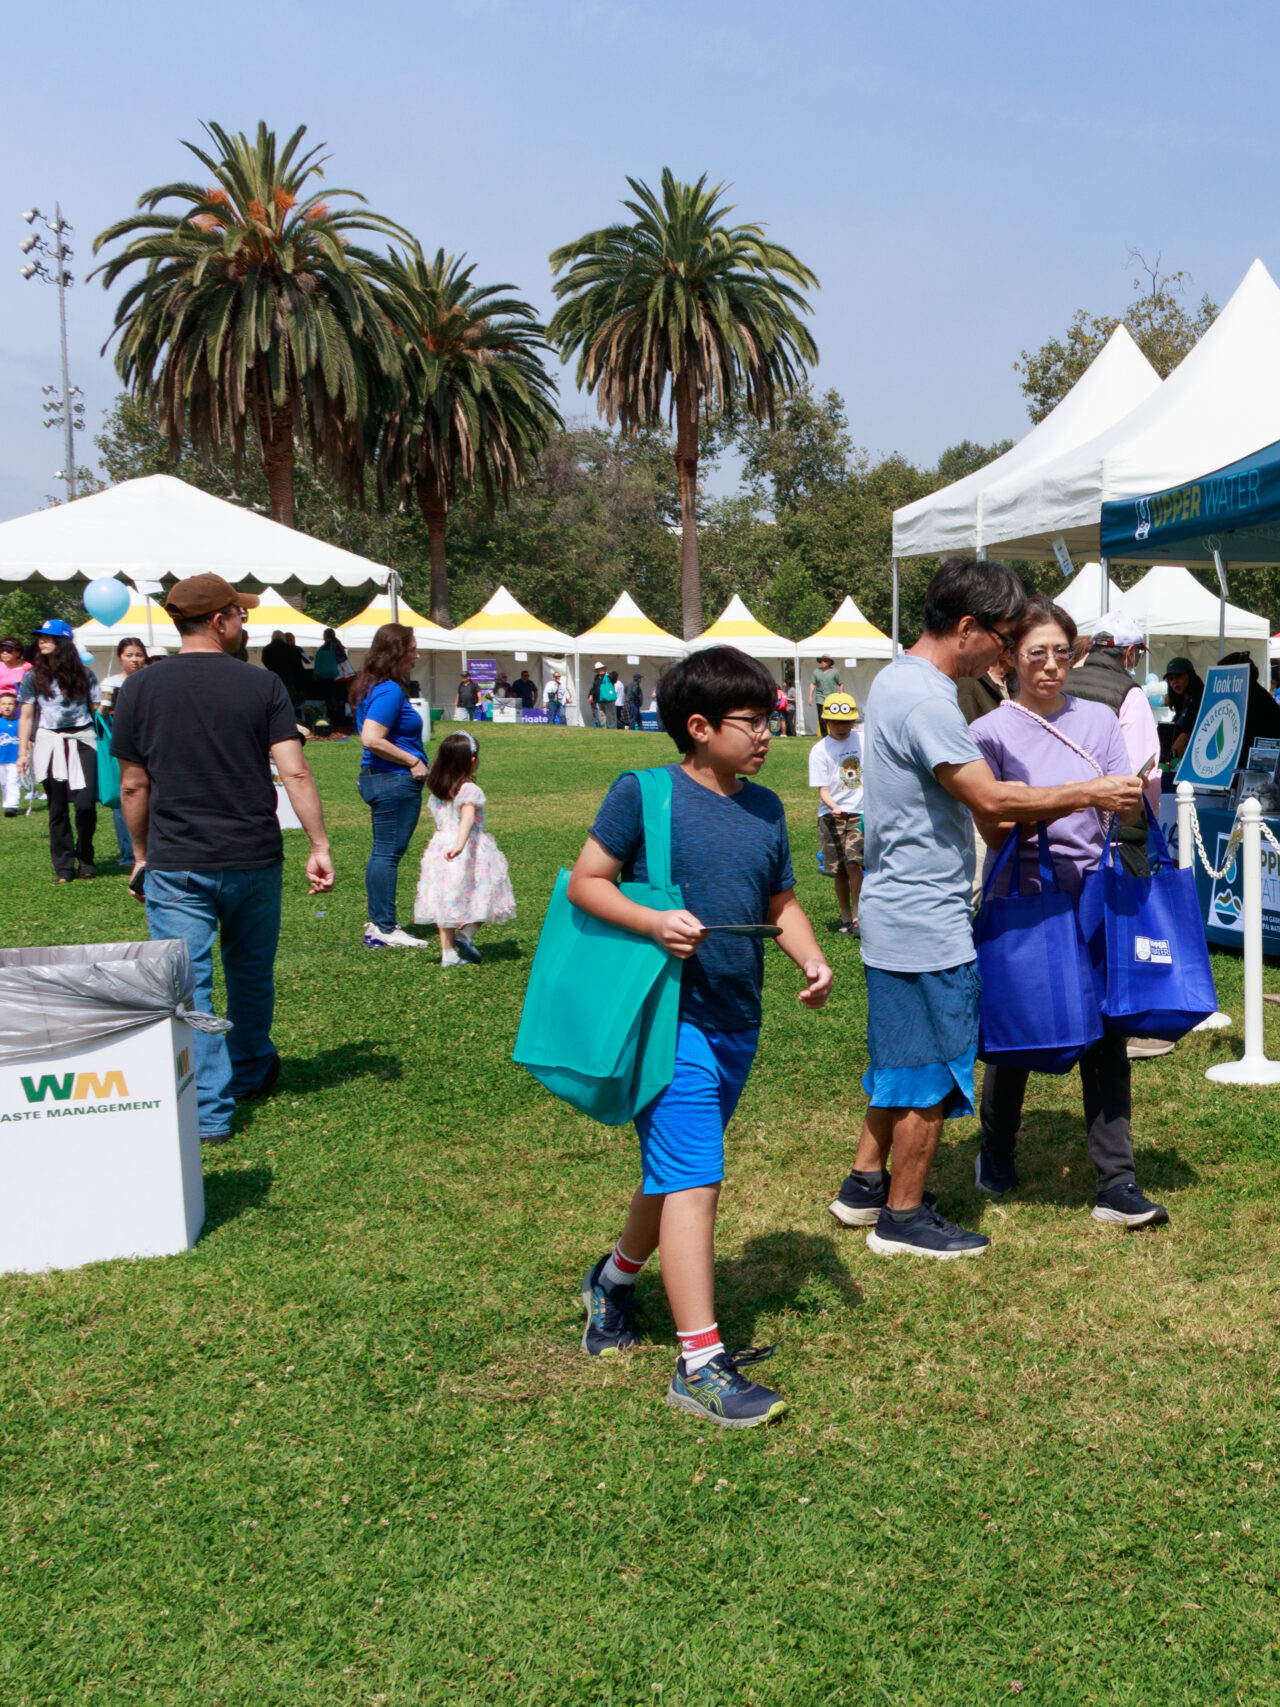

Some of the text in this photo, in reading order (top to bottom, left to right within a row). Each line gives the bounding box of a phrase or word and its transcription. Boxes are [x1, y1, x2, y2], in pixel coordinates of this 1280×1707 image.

[1151, 469, 1260, 528] UPPER WATER
[1213, 674, 1244, 693] look for
[1201, 703, 1238, 734] WaterSense
[1201, 765, 1214, 775] EPA
[20, 1070, 130, 1103] WM
[0, 1100, 162, 1123] ASTE MANAGEMENT
